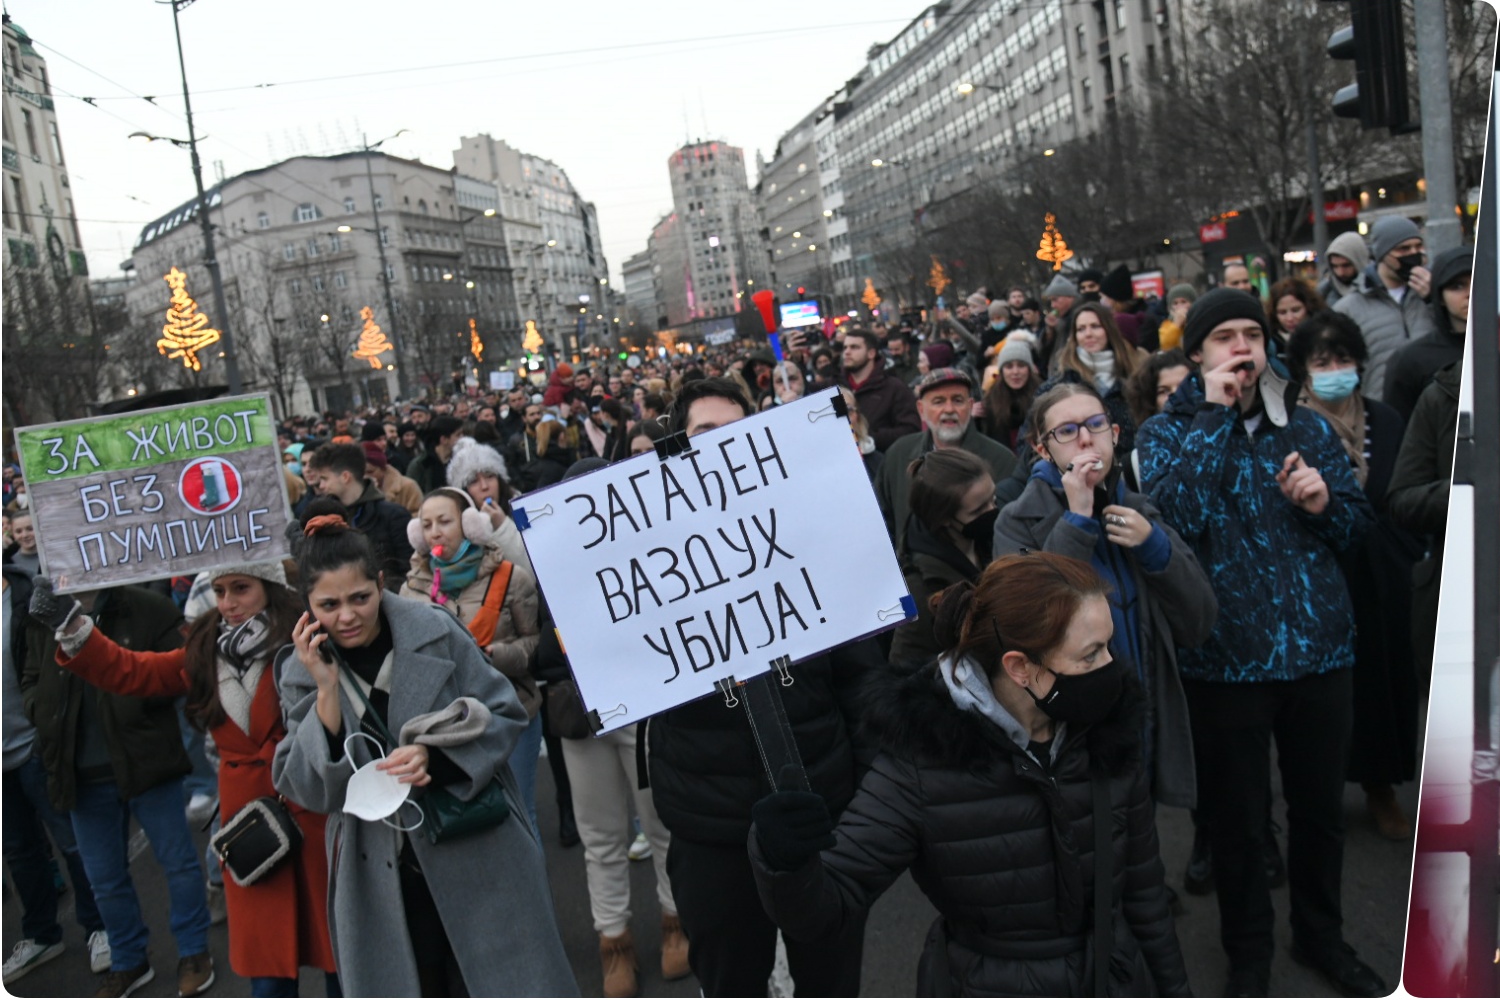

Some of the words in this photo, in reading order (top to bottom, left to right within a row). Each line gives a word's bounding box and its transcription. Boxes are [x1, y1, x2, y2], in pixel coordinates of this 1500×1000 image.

[41, 434, 101, 476] ЗА
[126, 409, 258, 461] ЖИВОТ
[564, 426, 788, 550] ЗАГАЂЕН
[77, 508, 271, 573] ПУМПИЦЕ
[79, 473, 164, 524] БЕЗ
[595, 507, 795, 624] ВАЗДУХ
[643, 567, 827, 684] УБИЈА!
